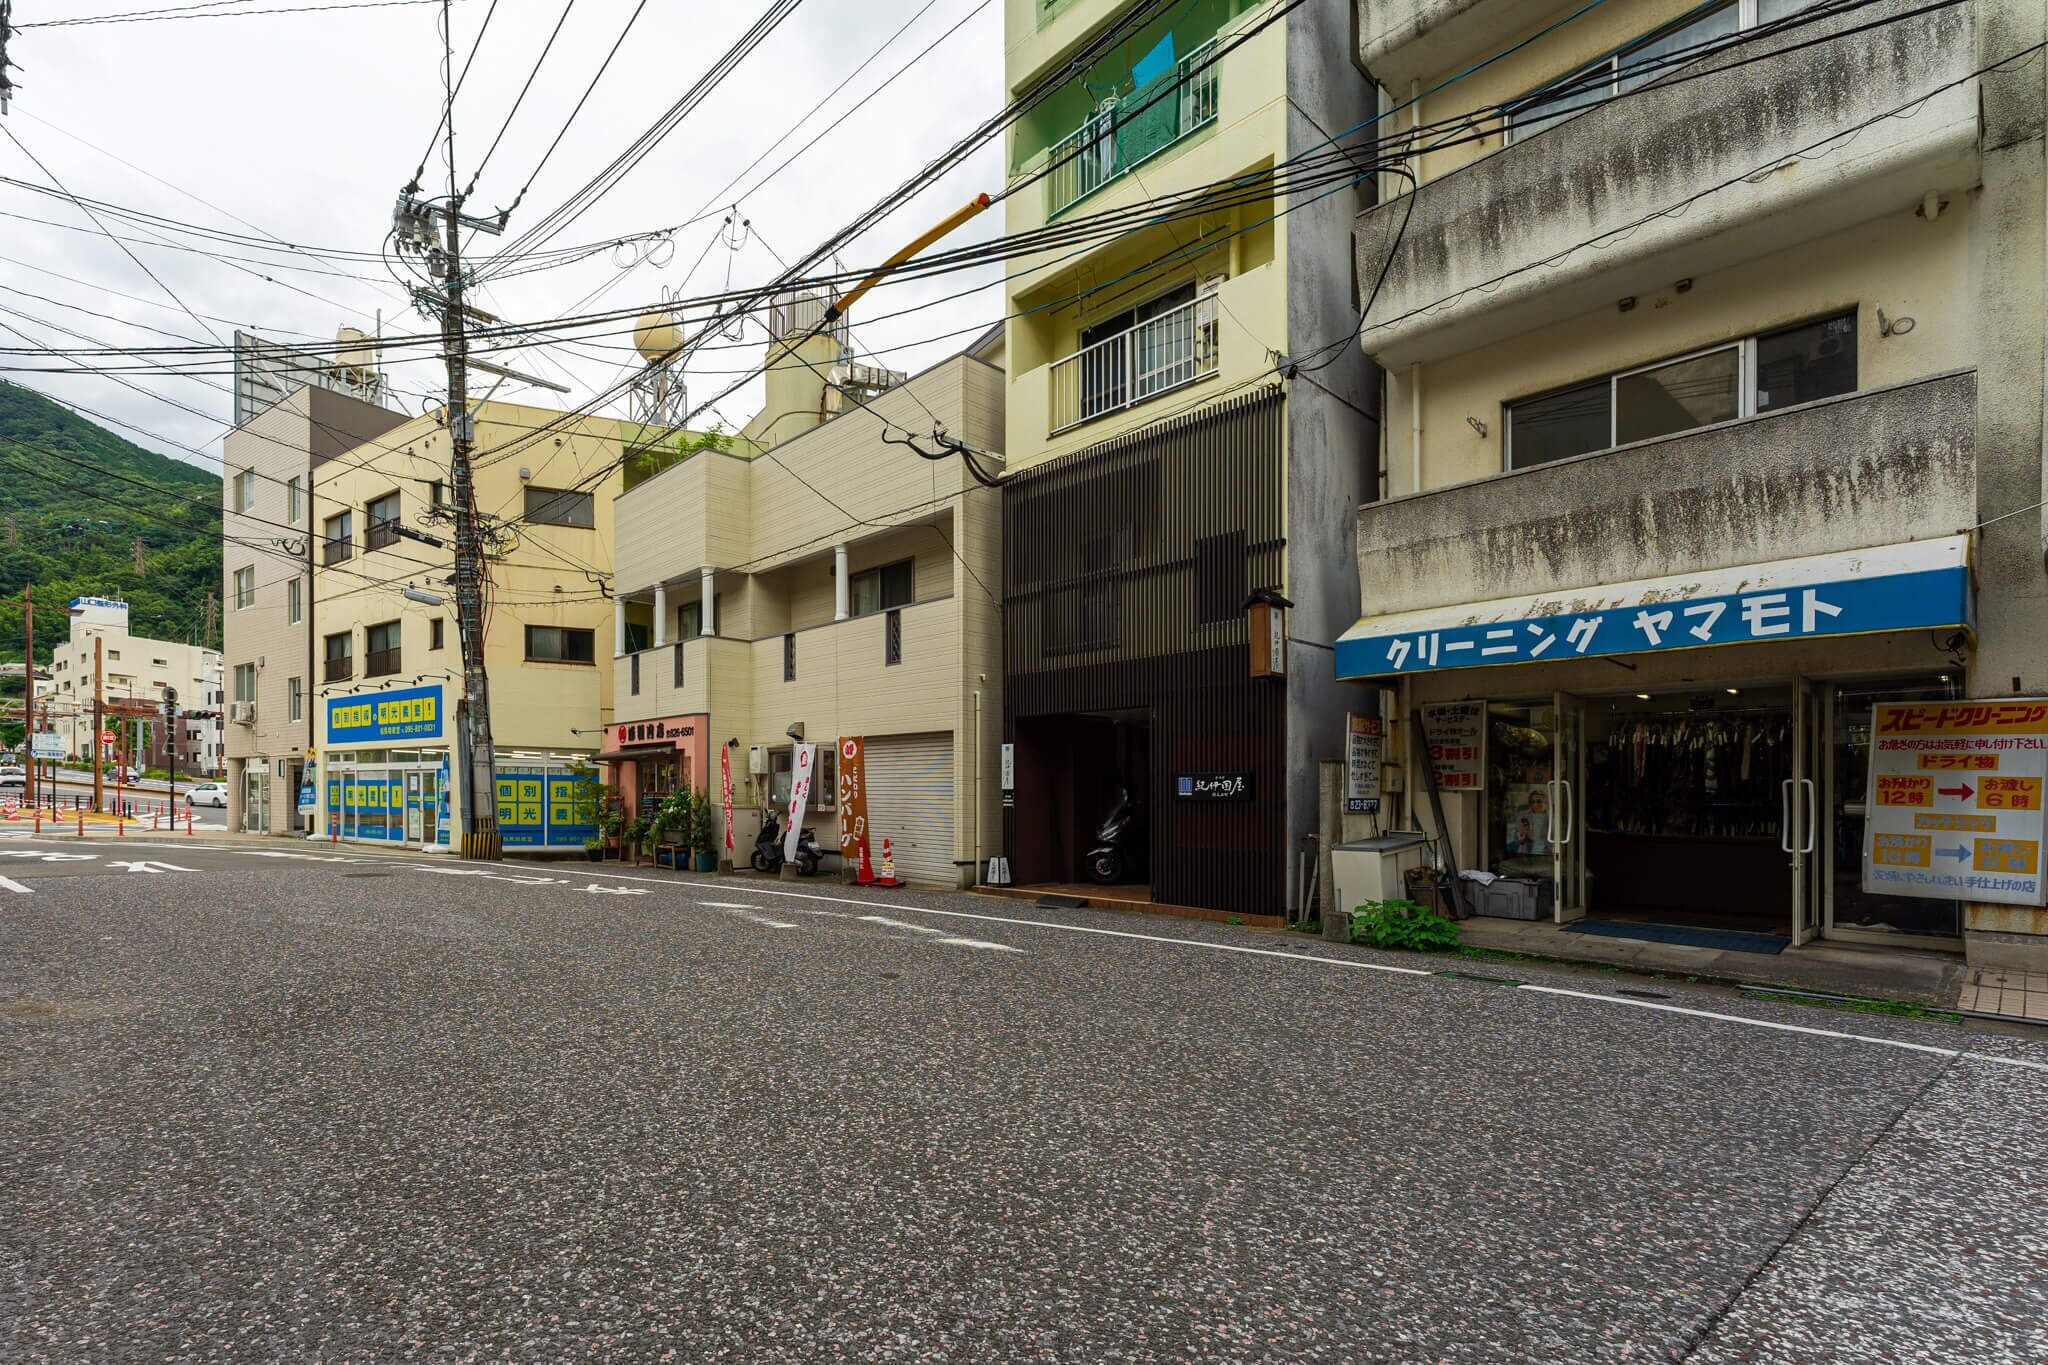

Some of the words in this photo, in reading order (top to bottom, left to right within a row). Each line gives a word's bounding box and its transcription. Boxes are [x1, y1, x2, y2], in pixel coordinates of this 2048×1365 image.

[1386, 617, 1604, 670] クリーニング
[1633, 589, 1844, 648] ヤマモト
[1879, 705, 2047, 732] スピードクリーニング
[1429, 746, 1478, 760] 3割引
[1922, 756, 1995, 769] ドライ物
[1878, 777, 1931, 790] お預かり
[1984, 779, 2033, 792] お渡し
[1882, 791, 1924, 804] 12時
[840, 774, 853, 848] ハンバーグ
